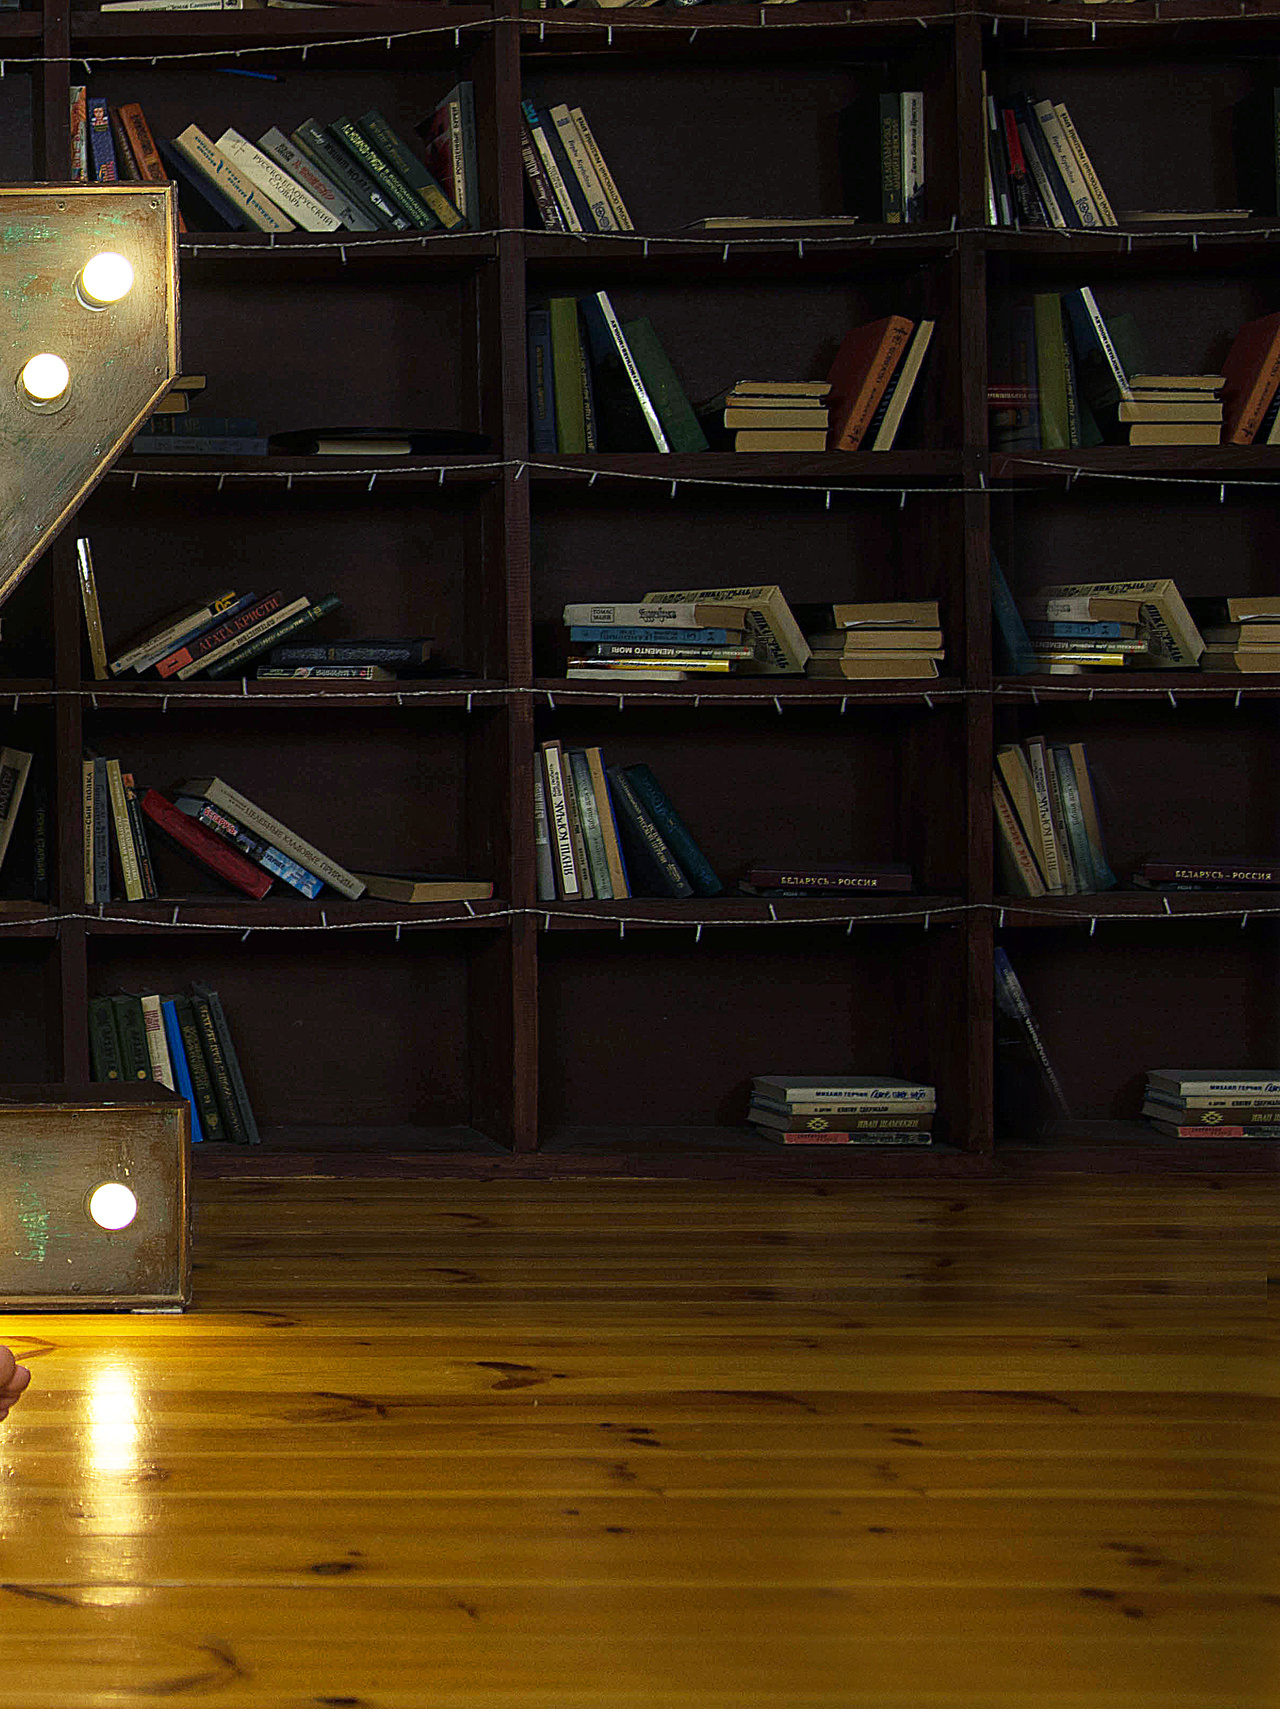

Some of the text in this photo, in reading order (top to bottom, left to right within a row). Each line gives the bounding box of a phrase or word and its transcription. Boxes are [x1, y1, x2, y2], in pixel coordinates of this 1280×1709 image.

[250, 154, 334, 226] РУССКО-БЕЛОРУССКИЙ
[266, 177, 301, 207] СЛОВАРЬ
[196, 624, 233, 652] АГАТА
[233, 596, 279, 630] КРИСТИ
[634, 646, 673, 655] MEMENTO
[202, 805, 240, 836] БЕЛАРУСЬ
[554, 800, 573, 875] ЯНУШ КОРЧАК
[1038, 796, 1056, 871] ЯНУШ КОРЧАК
[243, 806, 354, 889] ЦЕЛЕБНЫЕ КЛАДОВЫЕ ПРИРОДЫ
[781, 876, 830, 885] БЕЛАРУСЬ
[838, 878, 878, 887] РОССИЯ
[1175, 870, 1224, 879] БЕЛАРУСЬ
[1232, 872, 1272, 880] РОССИЯ
